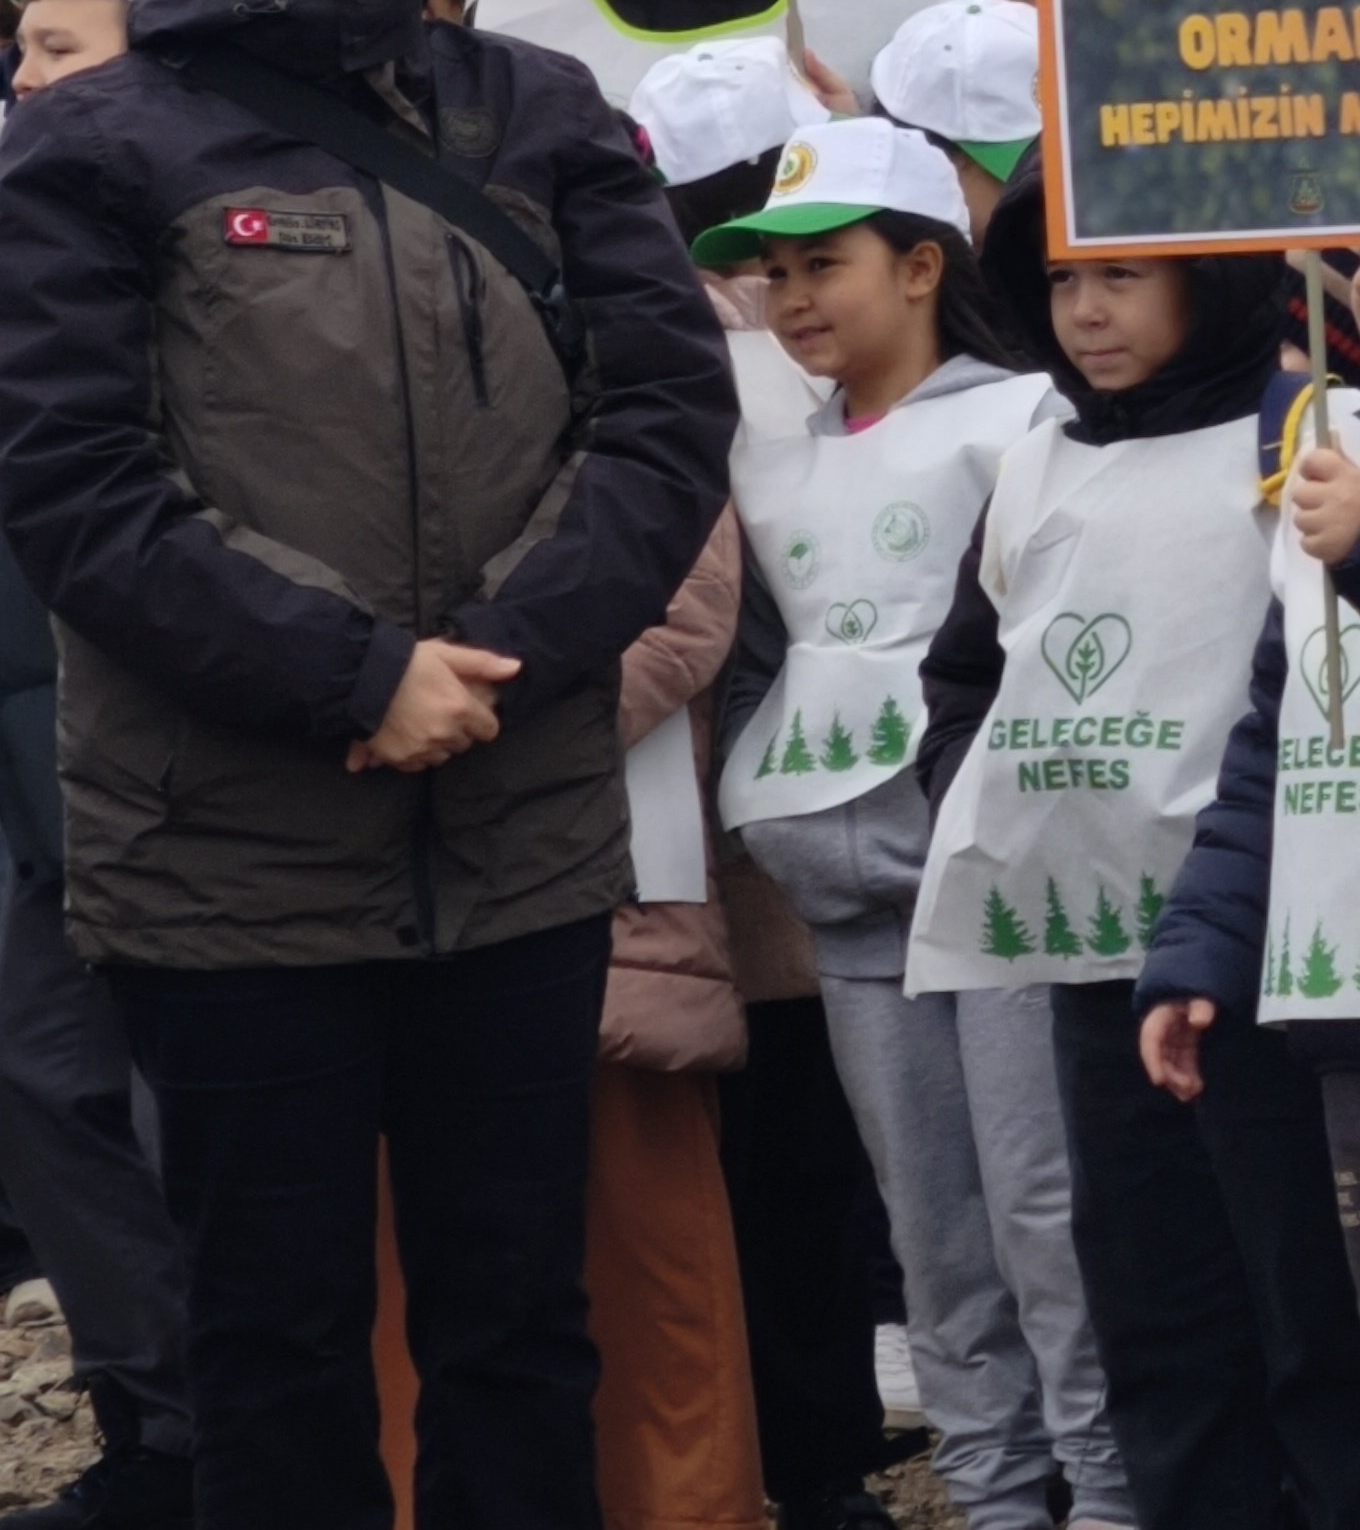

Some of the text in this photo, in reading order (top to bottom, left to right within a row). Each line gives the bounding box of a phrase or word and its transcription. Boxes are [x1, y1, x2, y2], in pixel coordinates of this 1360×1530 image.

[1100, 83, 1326, 147] HEPİMİZİN
[987, 712, 1185, 752] GELECEĞE
[1018, 759, 1130, 793] NEFES
